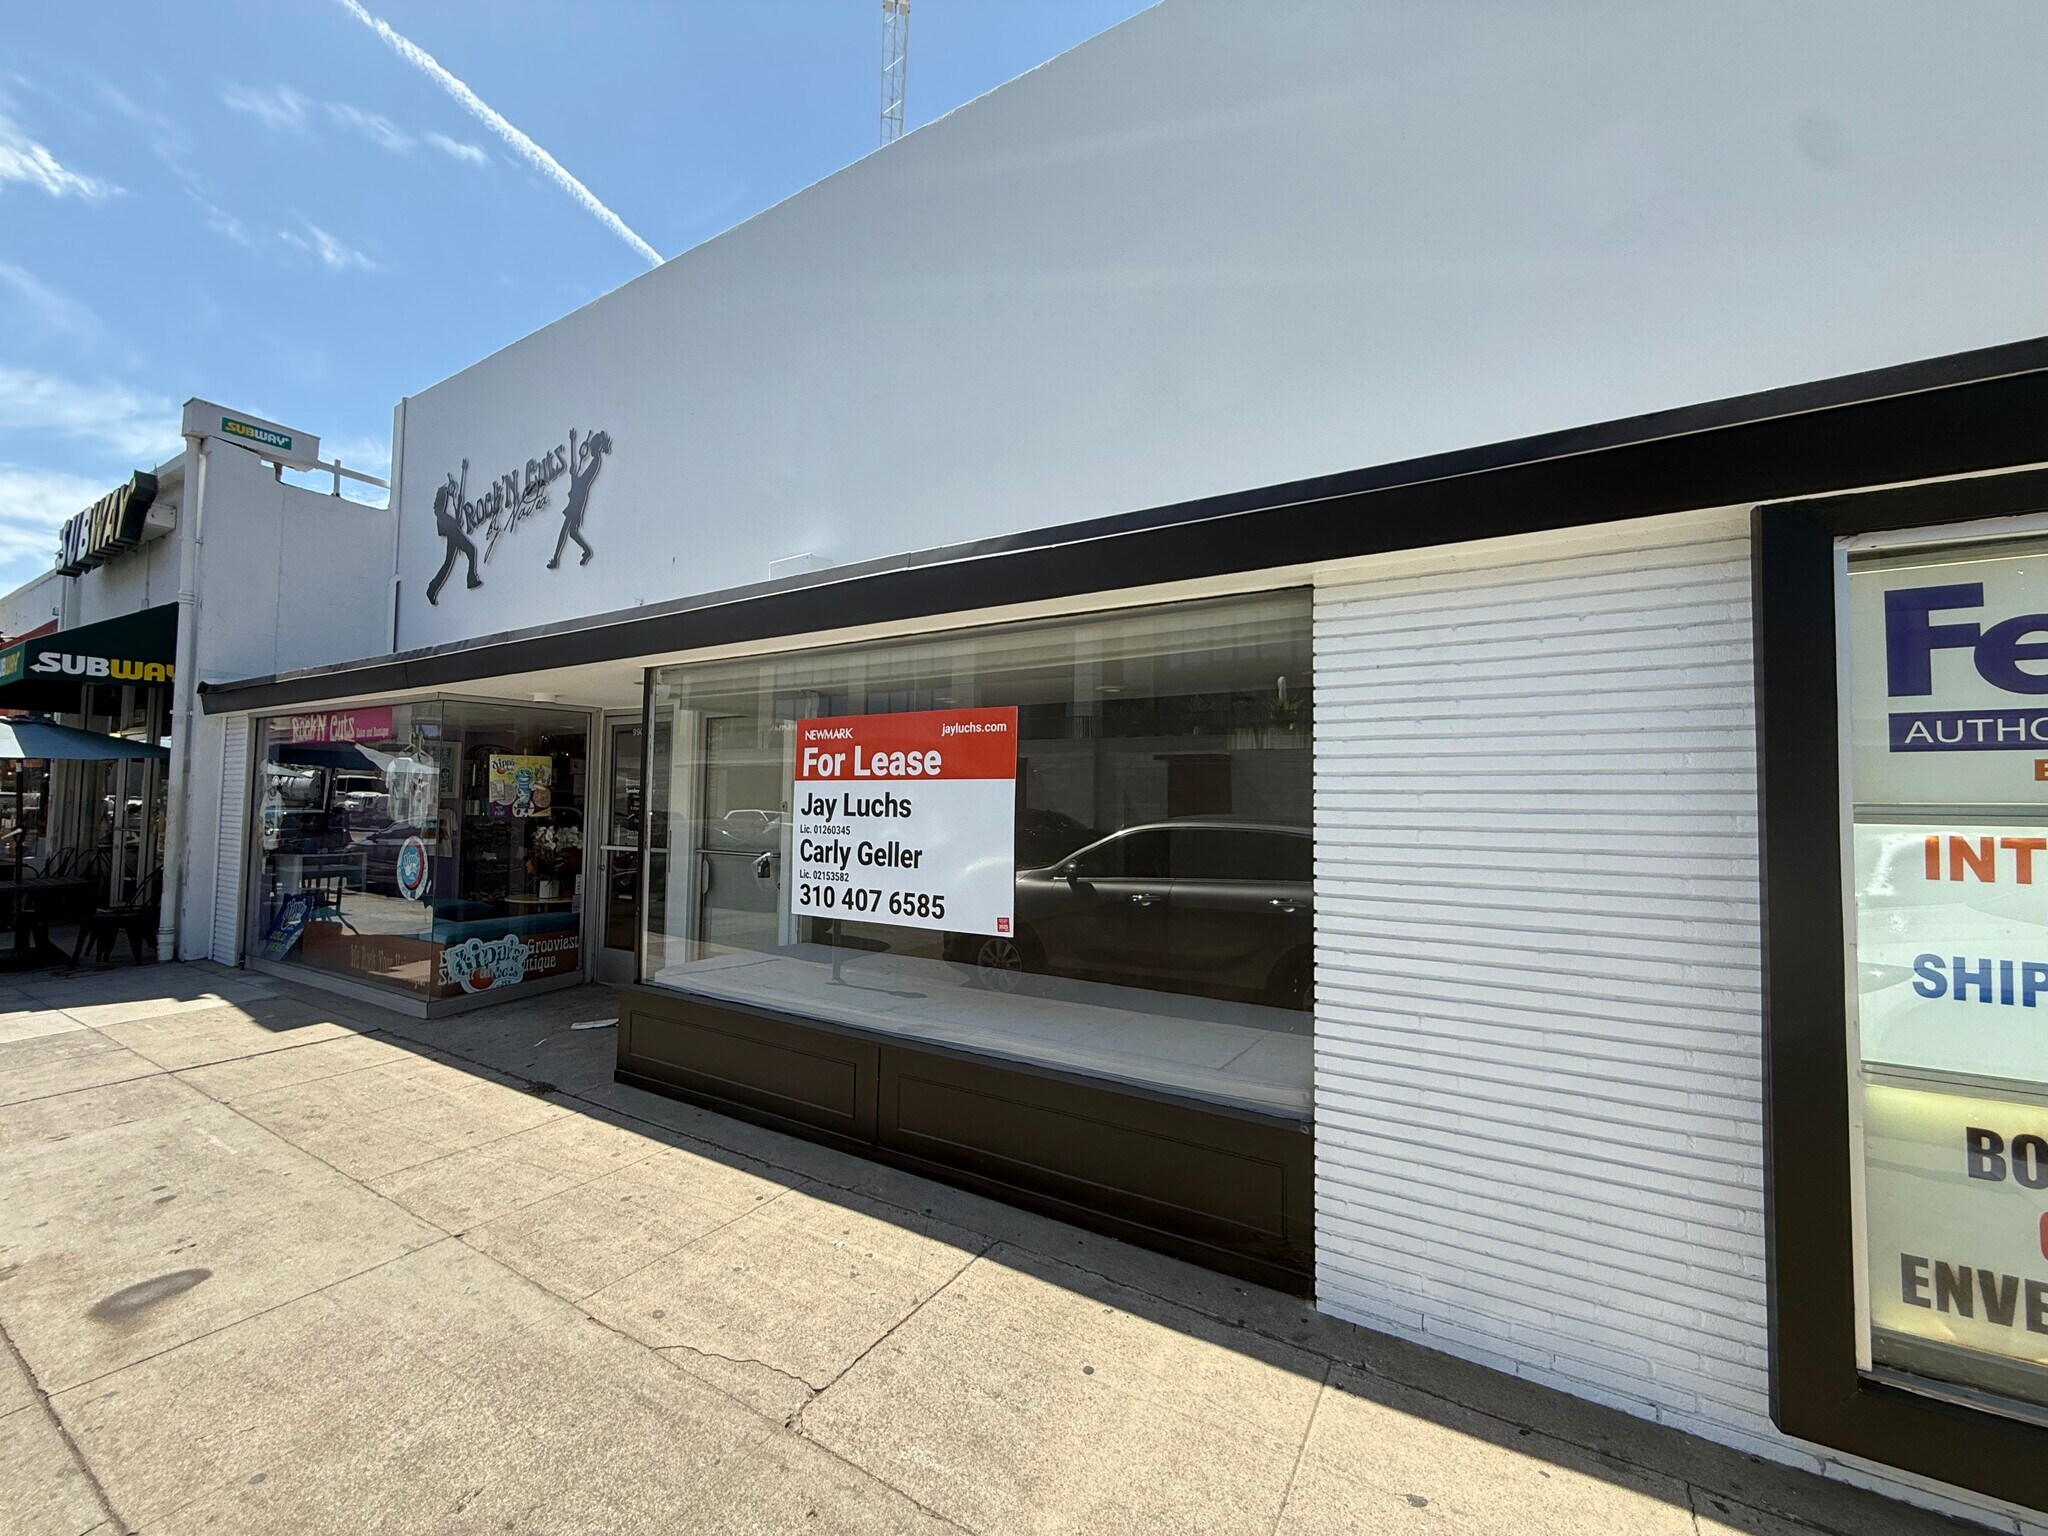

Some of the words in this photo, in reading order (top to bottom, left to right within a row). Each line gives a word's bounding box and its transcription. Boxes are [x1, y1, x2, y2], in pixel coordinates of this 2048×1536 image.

[225, 421, 290, 446] SUBWAY
[55, 474, 148, 572] SUBWAY
[804, 727, 853, 741] NEWMARK
[941, 721, 1007, 737] jayluchs.com
[802, 747, 846, 777] For
[853, 745, 942, 777] Lease
[800, 792, 837, 823] Jay
[843, 792, 912, 819] Luchs
[800, 824, 812, 834] Lic.
[813, 825, 851, 835] 01260345
[800, 838, 851, 871] Carly
[857, 841, 923, 869] Geller
[1925, 835, 2047, 884] INT
[799, 869, 812, 880] Lic.
[812, 871, 850, 882] 02153582
[799, 883, 836, 909] 310
[841, 888, 882, 913] 407
[888, 891, 946, 920] 6585
[527, 935, 580, 954] Grooviest
[1912, 953, 2048, 1008] SHIP
[1900, 1252, 2048, 1333] ENVE
